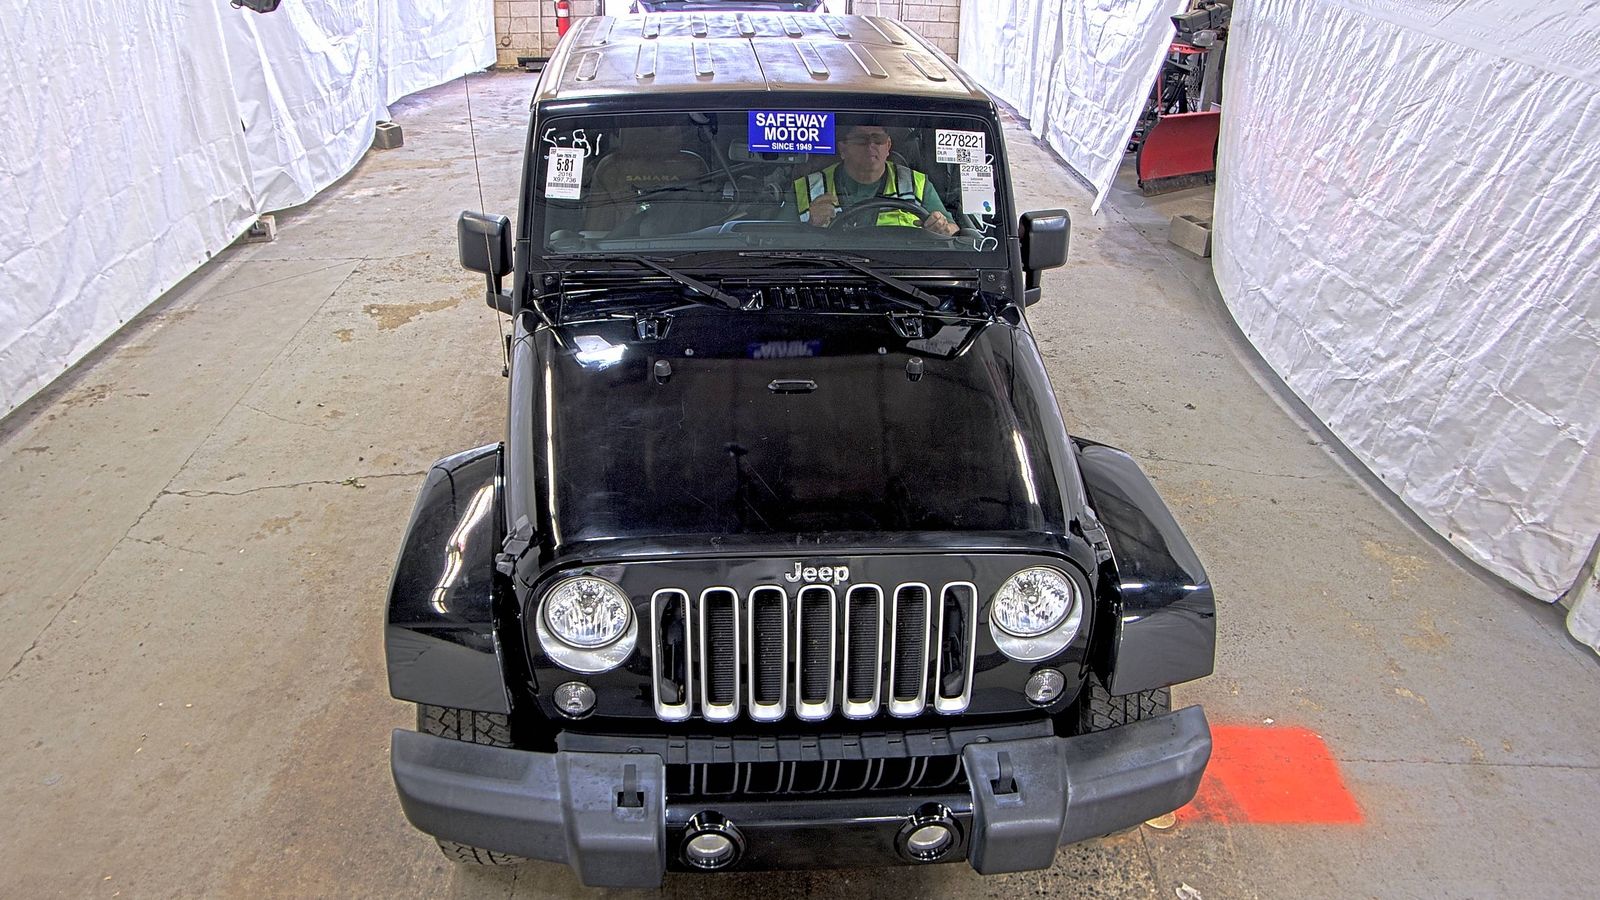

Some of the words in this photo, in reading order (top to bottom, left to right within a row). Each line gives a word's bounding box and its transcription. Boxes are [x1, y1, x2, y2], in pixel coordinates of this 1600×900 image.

[756, 113, 828, 128] SAFEWAY
[764, 127, 819, 142] MOTOR
[938, 133, 983, 148] 2278221
[771, 142, 794, 150] SINCE
[796, 143, 812, 151] 1949
[556, 159, 574, 171] 5:81
[961, 165, 992, 173] 2278221
[784, 561, 850, 586] Jeep
